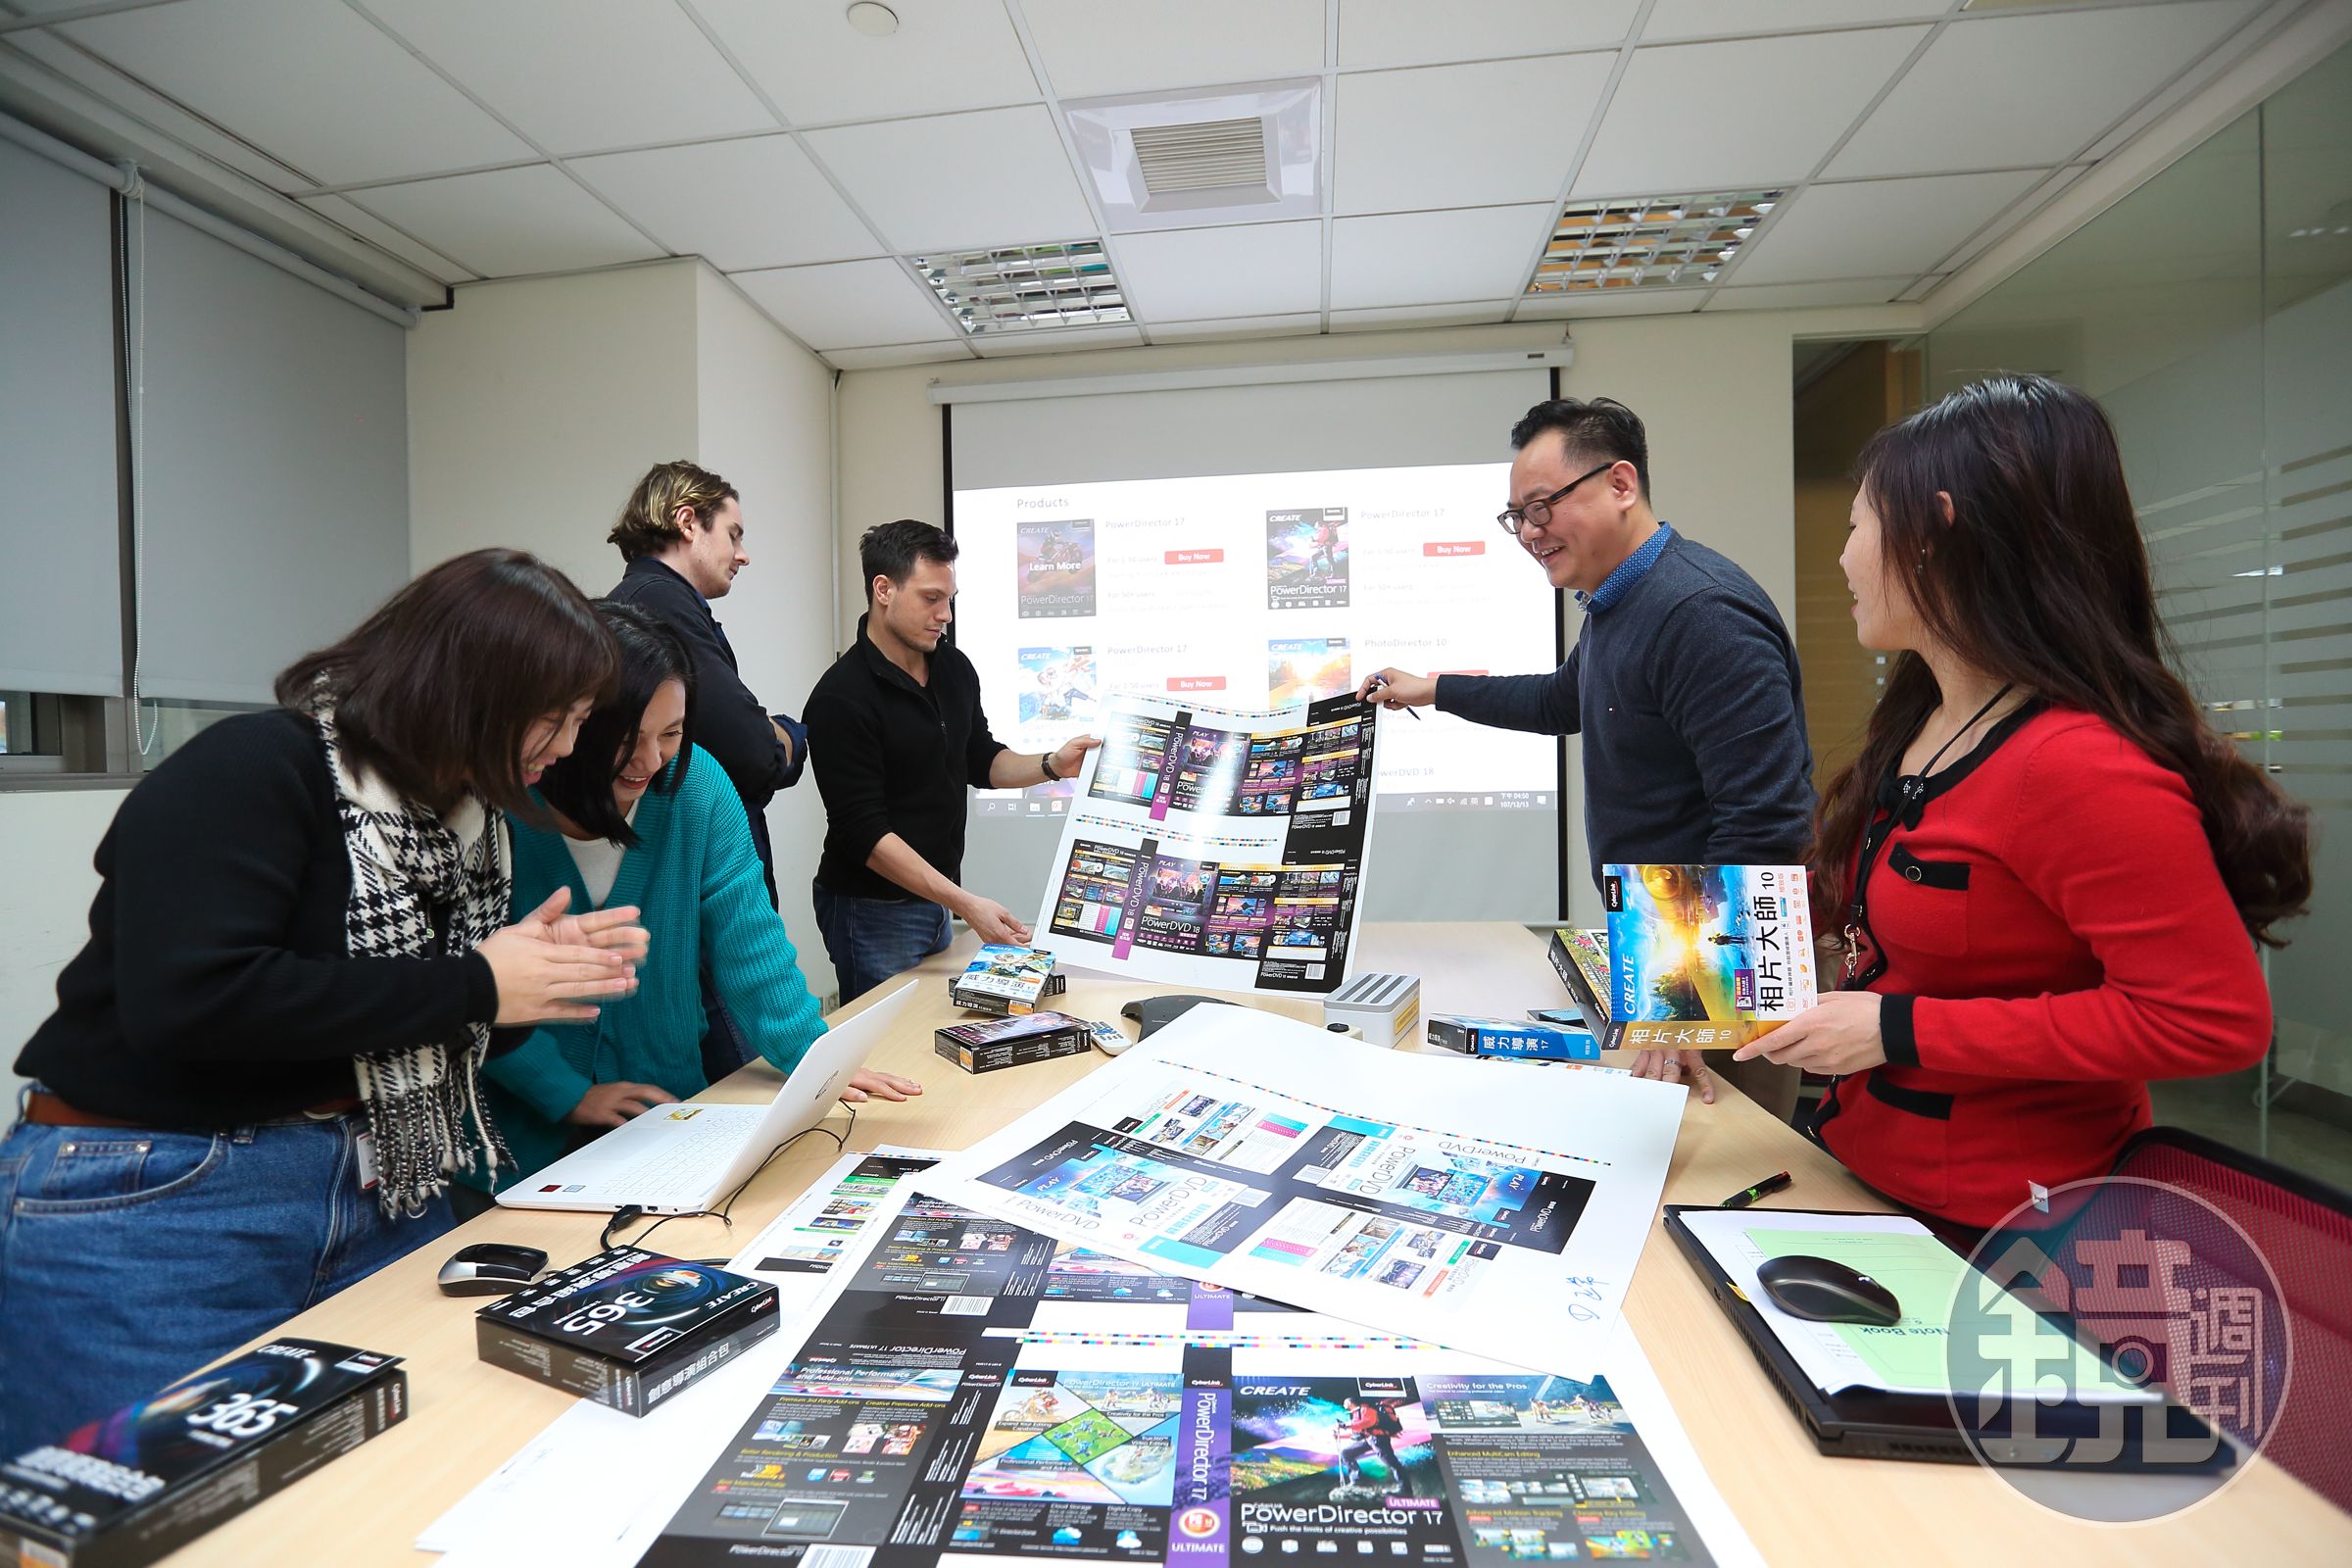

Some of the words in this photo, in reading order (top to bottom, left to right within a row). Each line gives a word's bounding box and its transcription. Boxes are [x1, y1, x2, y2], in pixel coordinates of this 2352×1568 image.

[1016, 497, 1069, 509] Products
[1269, 514, 1301, 522] CREATE
[1360, 510, 1431, 519] PowerDirector
[1434, 508, 1445, 516] 17
[1105, 519, 1172, 529] PowerDirector
[1175, 517, 1185, 526] 17
[1029, 562, 1054, 571] Learn
[1056, 561, 1081, 570] More
[1270, 585, 1338, 595] PowerDirector
[1020, 595, 1084, 605] PowerDirector
[1107, 646, 1174, 655] PowerDirector
[1176, 644, 1187, 653] 17
[1364, 639, 1433, 648] PhotoDirector
[1436, 637, 1447, 647] 10
[1021, 652, 1051, 661] CREATE
[1195, 679, 1212, 688] Now
[1165, 732, 1184, 776] PowerDVD
[1130, 861, 1150, 907] PowerDVD
[1760, 871, 1775, 890] 10
[1610, 880, 1619, 908] CyberLink
[1142, 915, 1191, 932] PowerDVD
[1193, 925, 1200, 934] 18
[1753, 896, 1784, 1011] 相片大師
[965, 974, 1025, 989] 威力導演
[1623, 953, 1637, 1015] CREATE
[1483, 1035, 1539, 1051] 威力導演
[1541, 1040, 1549, 1049] 17
[1629, 1028, 1716, 1044] 相片大師
[1719, 1030, 1732, 1040] 10
[1044, 1139, 1078, 1161] PowerDVD
[1438, 1141, 1526, 1164] PowerDVD
[1359, 1146, 1416, 1195] PowerDVD
[1037, 1176, 1060, 1192] PLAY
[1508, 1173, 1525, 1191] PLAY
[1128, 1176, 1207, 1227] PowerDVD
[1016, 1198, 1100, 1230] PowerDVD
[1530, 1207, 1551, 1233] PowerDVD
[705, 1281, 759, 1310] CREATE
[751, 1297, 773, 1313] CyberLink
[563, 1291, 654, 1336] 365
[1859, 1327, 1906, 1336] Book
[255, 1344, 316, 1359] CREATE
[889, 1345, 967, 1355] PowerDirector
[801, 1367, 854, 1377] Professional
[855, 1369, 910, 1378] Performance
[1063, 1378, 1130, 1389] PowerDirector
[1191, 1379, 1223, 1388] CyberLink
[1239, 1386, 1311, 1396] CREATE
[1426, 1382, 1470, 1391] Creativity
[392, 1382, 401, 1416] CyberLink
[186, 1393, 300, 1437] 365
[1192, 1392, 1216, 1487] PowerDirector
[1191, 1488, 1207, 1500] 17
[1389, 1498, 1437, 1508] ULTIMATE
[1241, 1503, 1417, 1525] PowerDirector
[1423, 1510, 1444, 1526] 17
[1333, 1526, 1363, 1535] creative
[1364, 1527, 1408, 1536] possibilities
[1171, 1543, 1225, 1553] ULTIMATE
